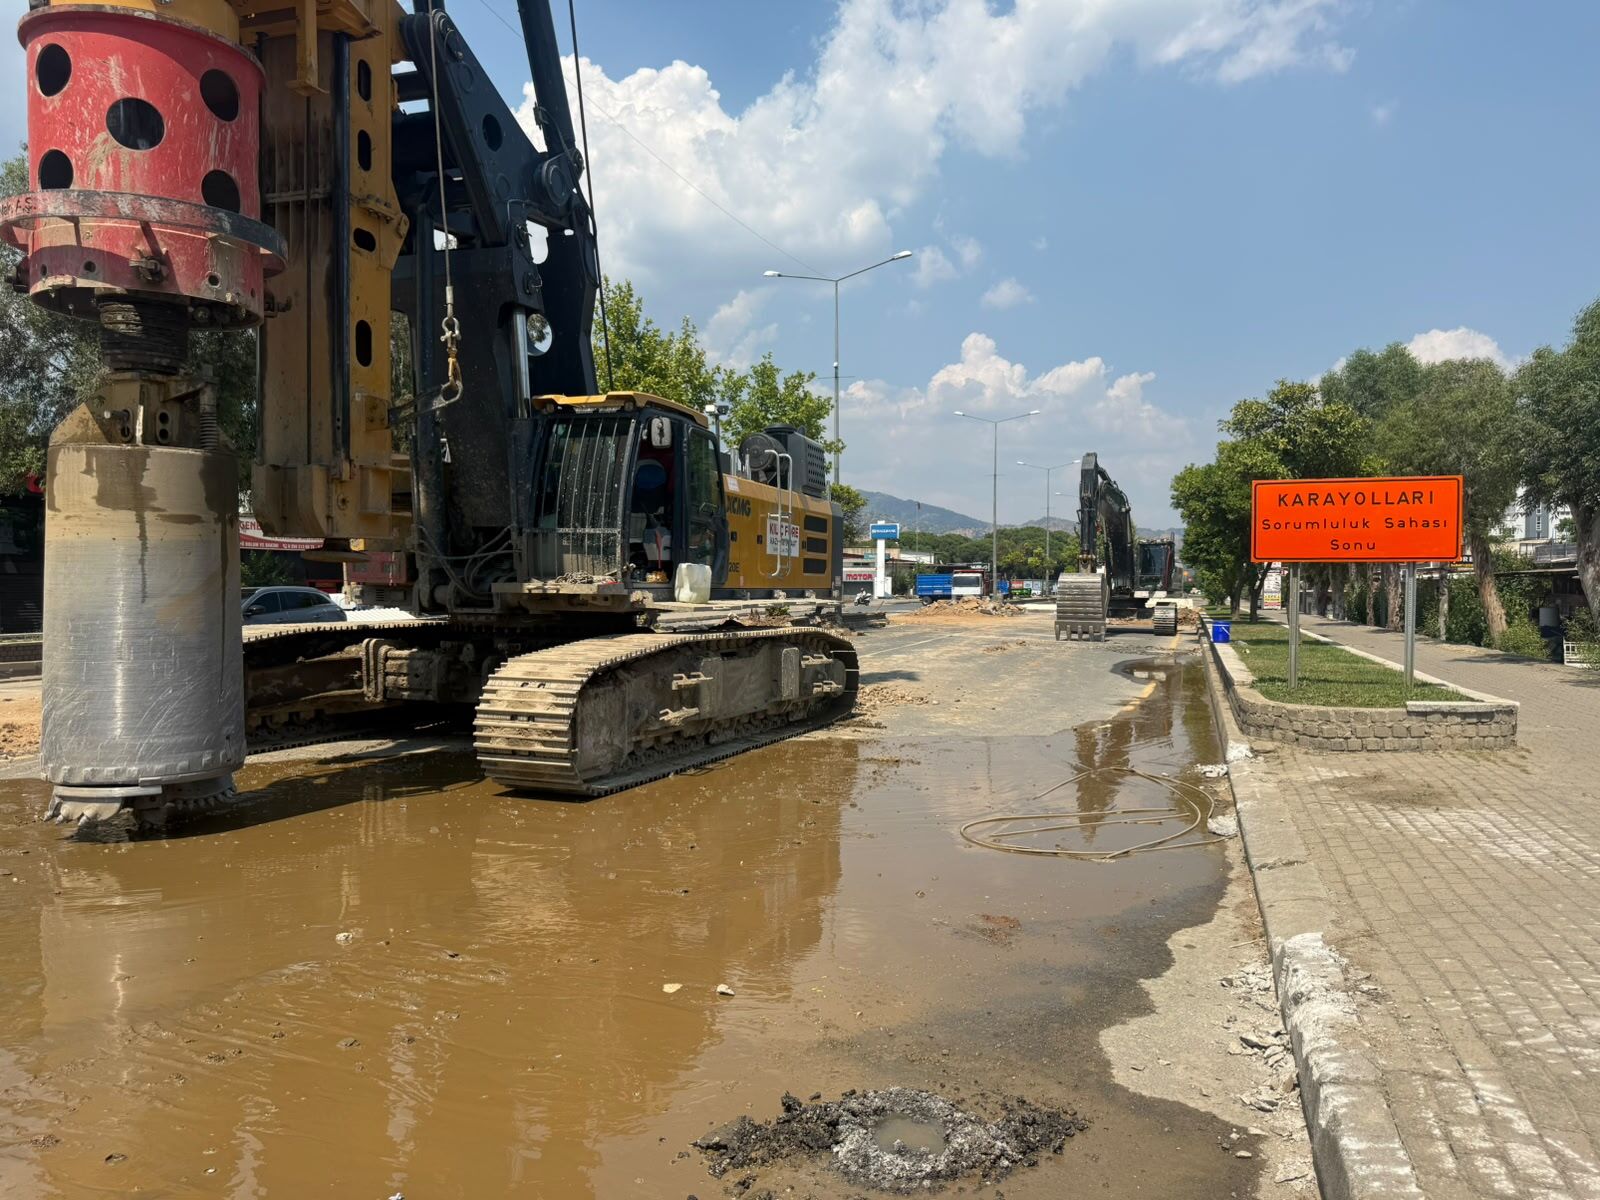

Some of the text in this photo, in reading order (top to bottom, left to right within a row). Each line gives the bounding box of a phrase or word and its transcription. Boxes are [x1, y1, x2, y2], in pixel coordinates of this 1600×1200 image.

[1278, 491, 1434, 507] KARAYOLLARI
[1262, 517, 1448, 530] Sorumluluk Sahası
[1330, 539, 1376, 551] Sonu
[846, 573, 873, 581] MOTOR
